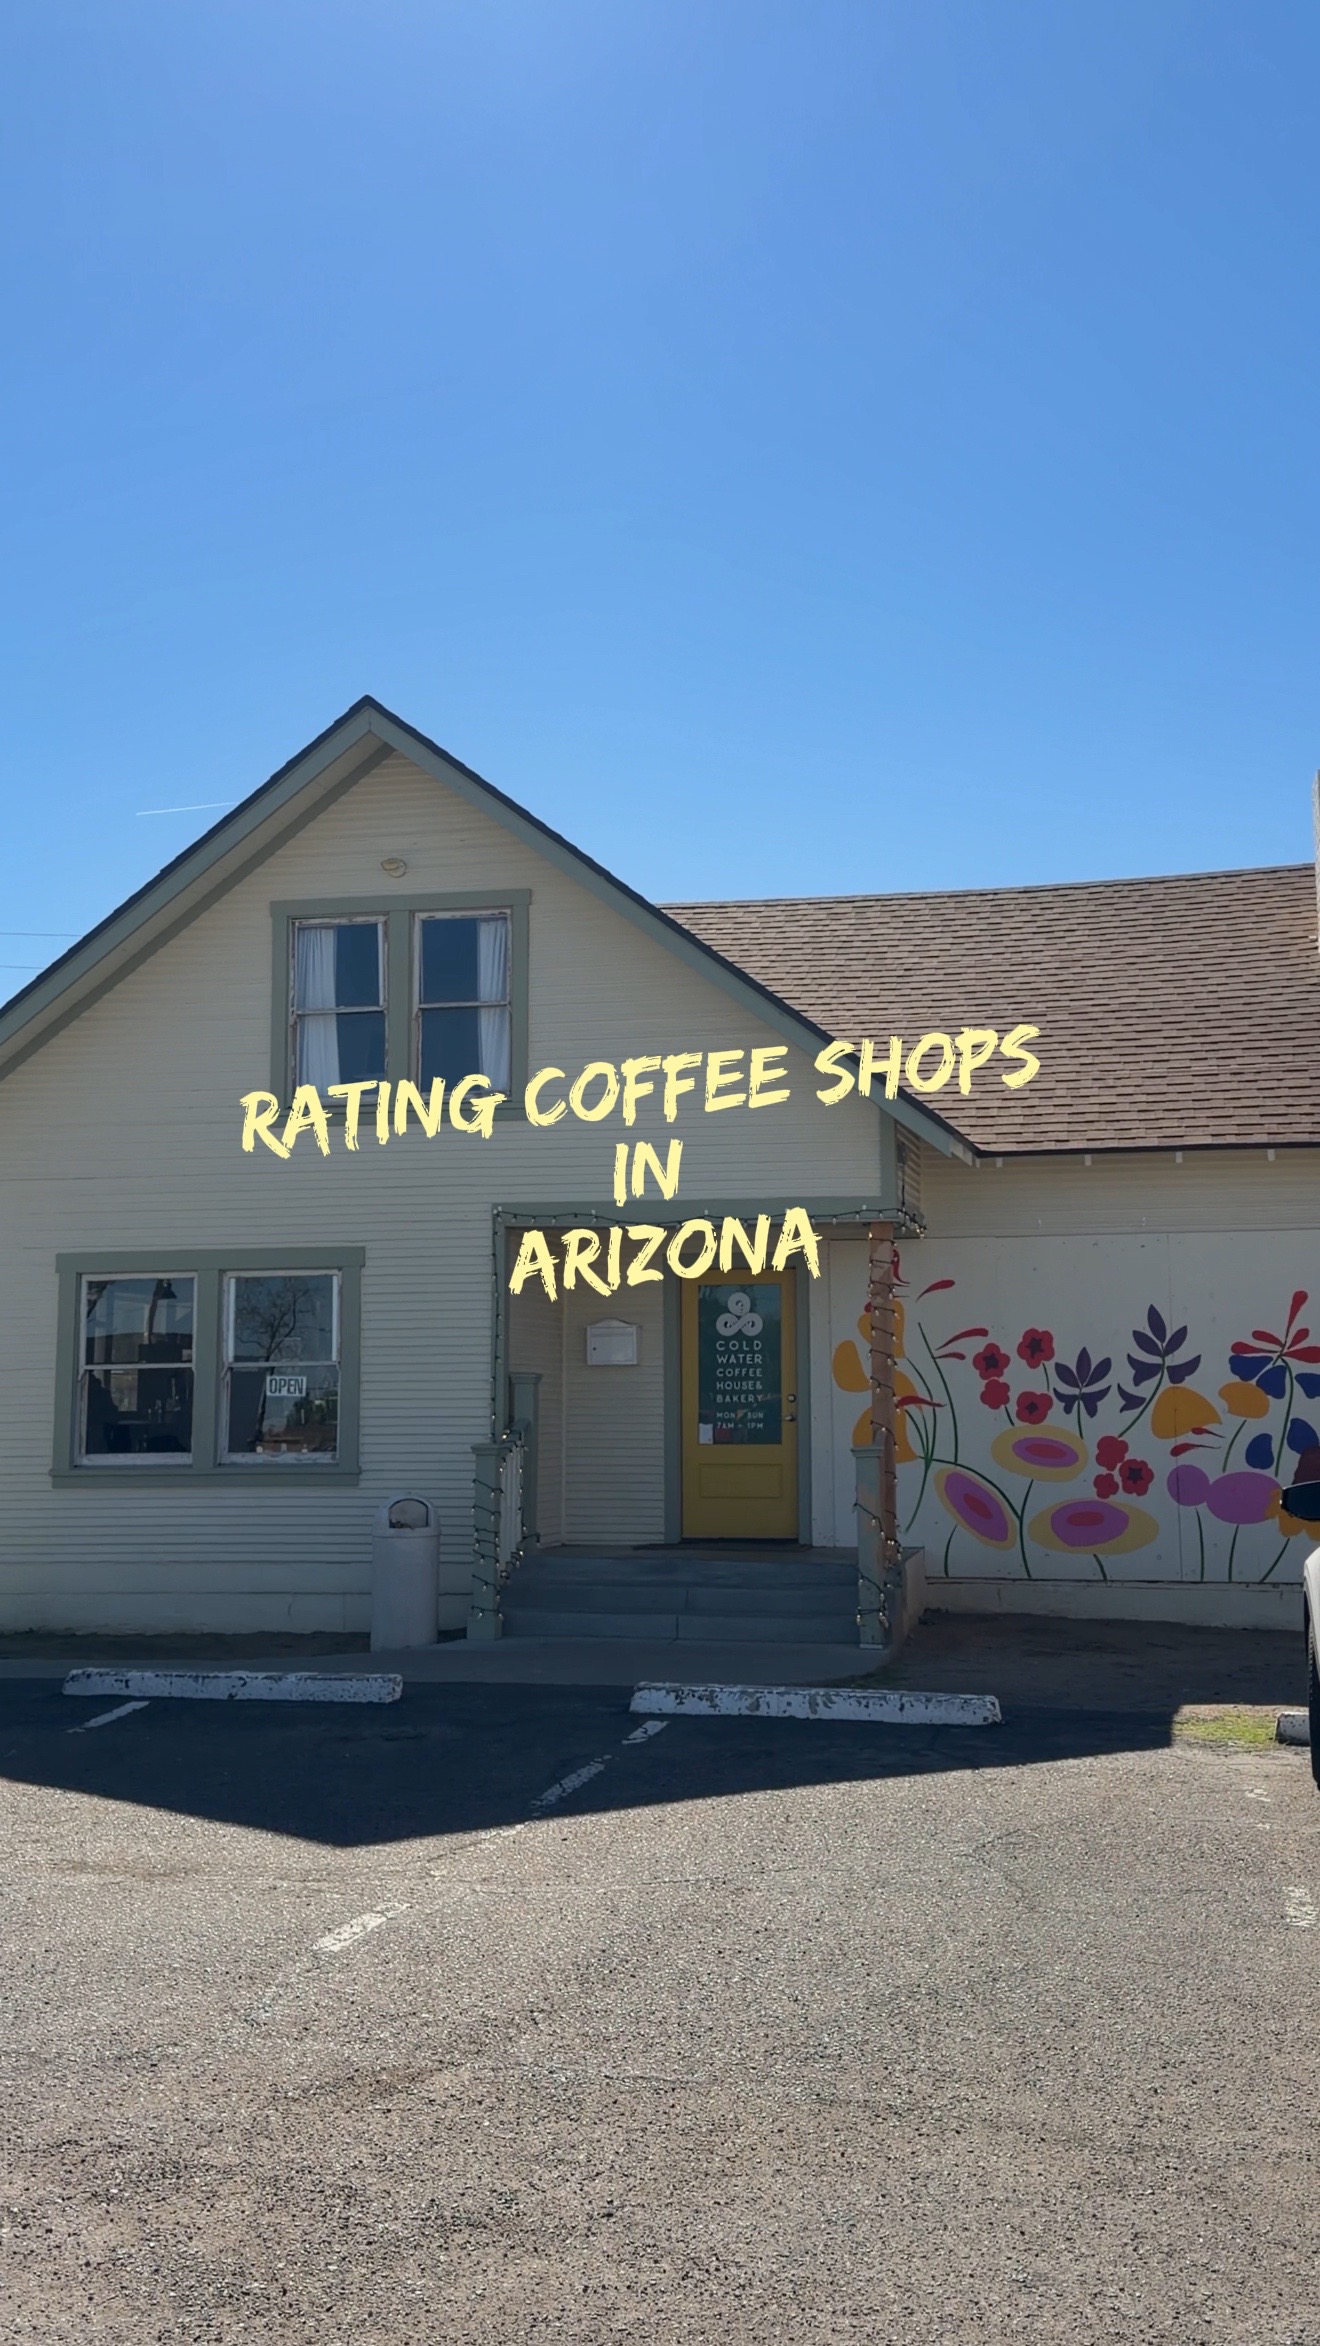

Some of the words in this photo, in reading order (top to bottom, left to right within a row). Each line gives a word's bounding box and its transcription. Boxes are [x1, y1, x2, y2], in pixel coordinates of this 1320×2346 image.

[716, 1340, 762, 1351] COLD
[716, 1354, 763, 1364] WATER
[716, 1368, 763, 1377] COFFEE
[269, 1378, 304, 1395] OPEN
[716, 1394, 763, 1403] BAKERY
[716, 1411, 736, 1419] MON
[747, 1411, 764, 1419] SUN
